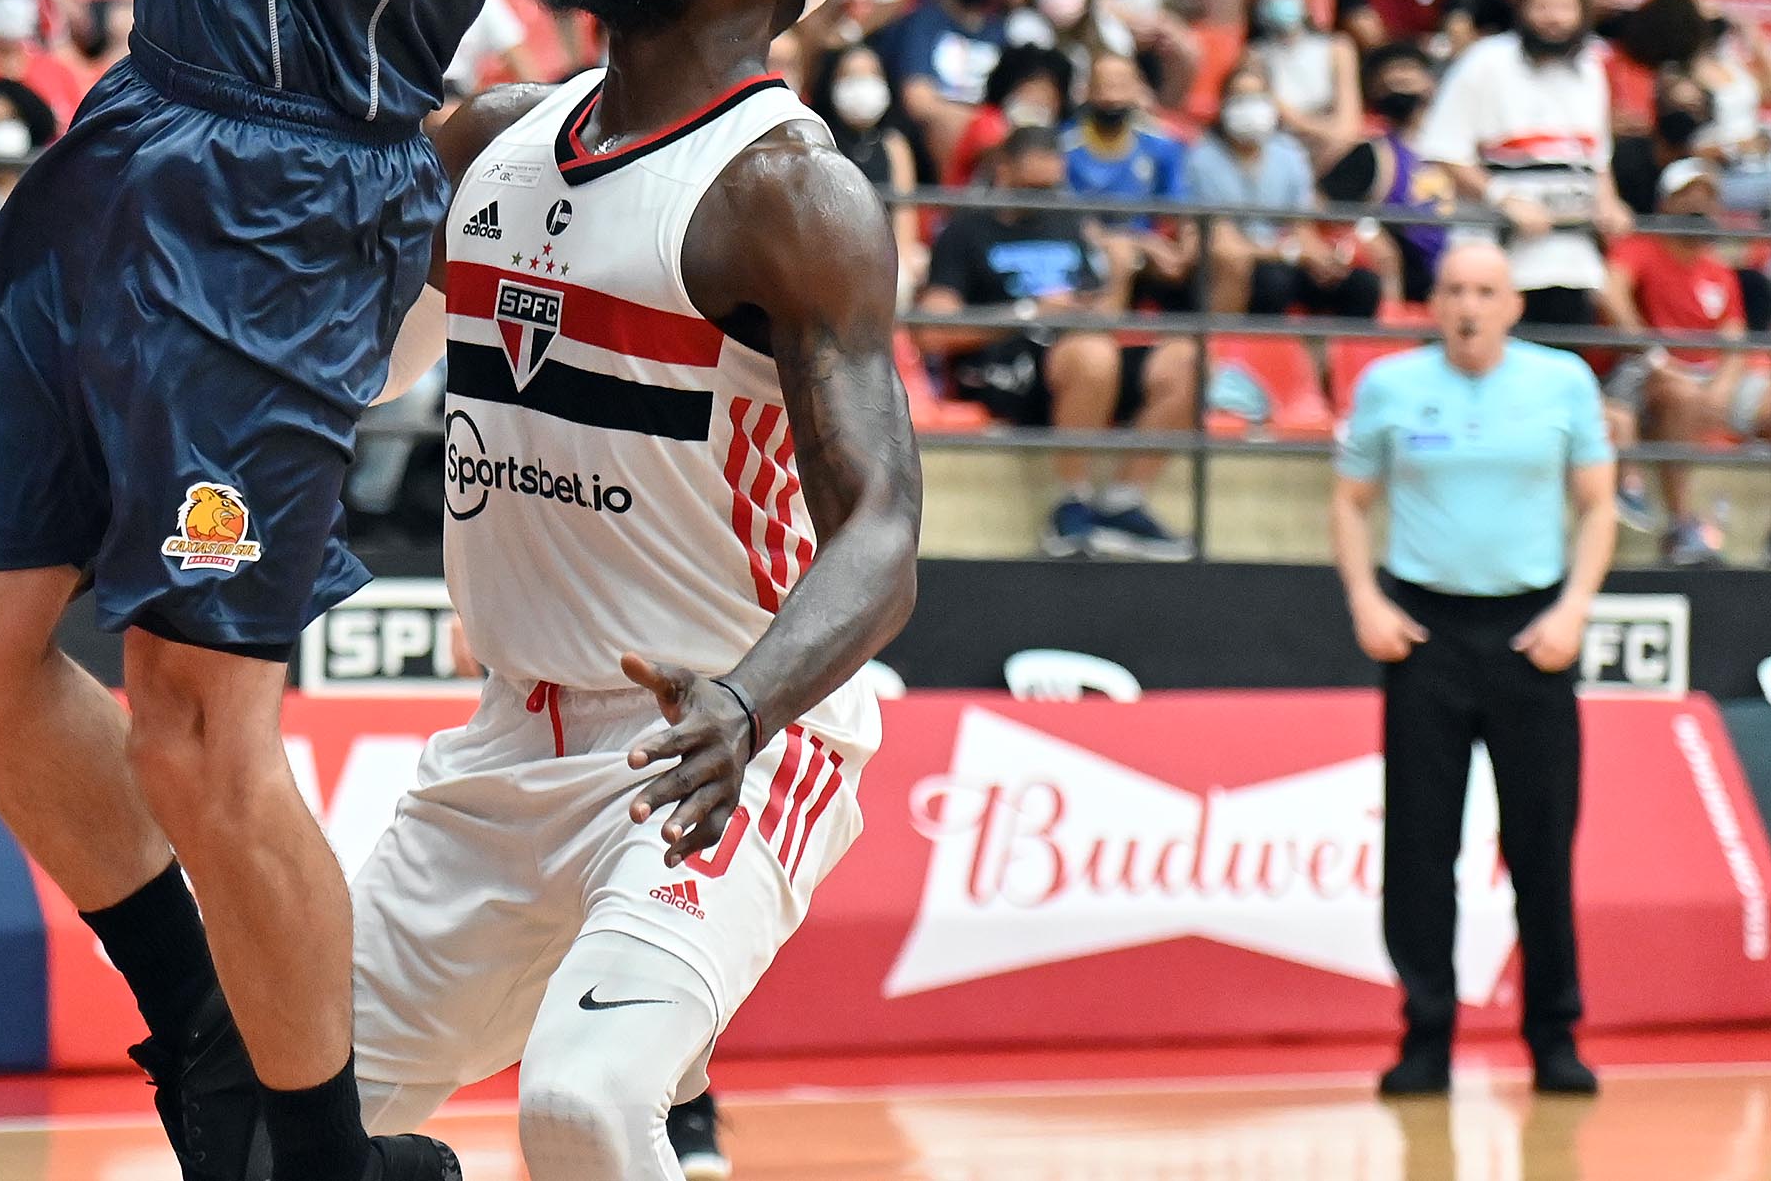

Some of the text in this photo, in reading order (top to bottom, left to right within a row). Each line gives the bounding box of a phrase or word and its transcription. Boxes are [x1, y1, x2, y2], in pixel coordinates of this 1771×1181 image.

[463, 223, 502, 240] adidas
[502, 290, 558, 322] SPFC
[447, 442, 633, 514] Sportsbet.io
[166, 539, 257, 557] CAXIAS DO SUL
[188, 556, 235, 567] BASQUETE
[1580, 623, 1668, 682] FC
[908, 781, 1385, 908] Budwei
[649, 888, 706, 920] adidas
